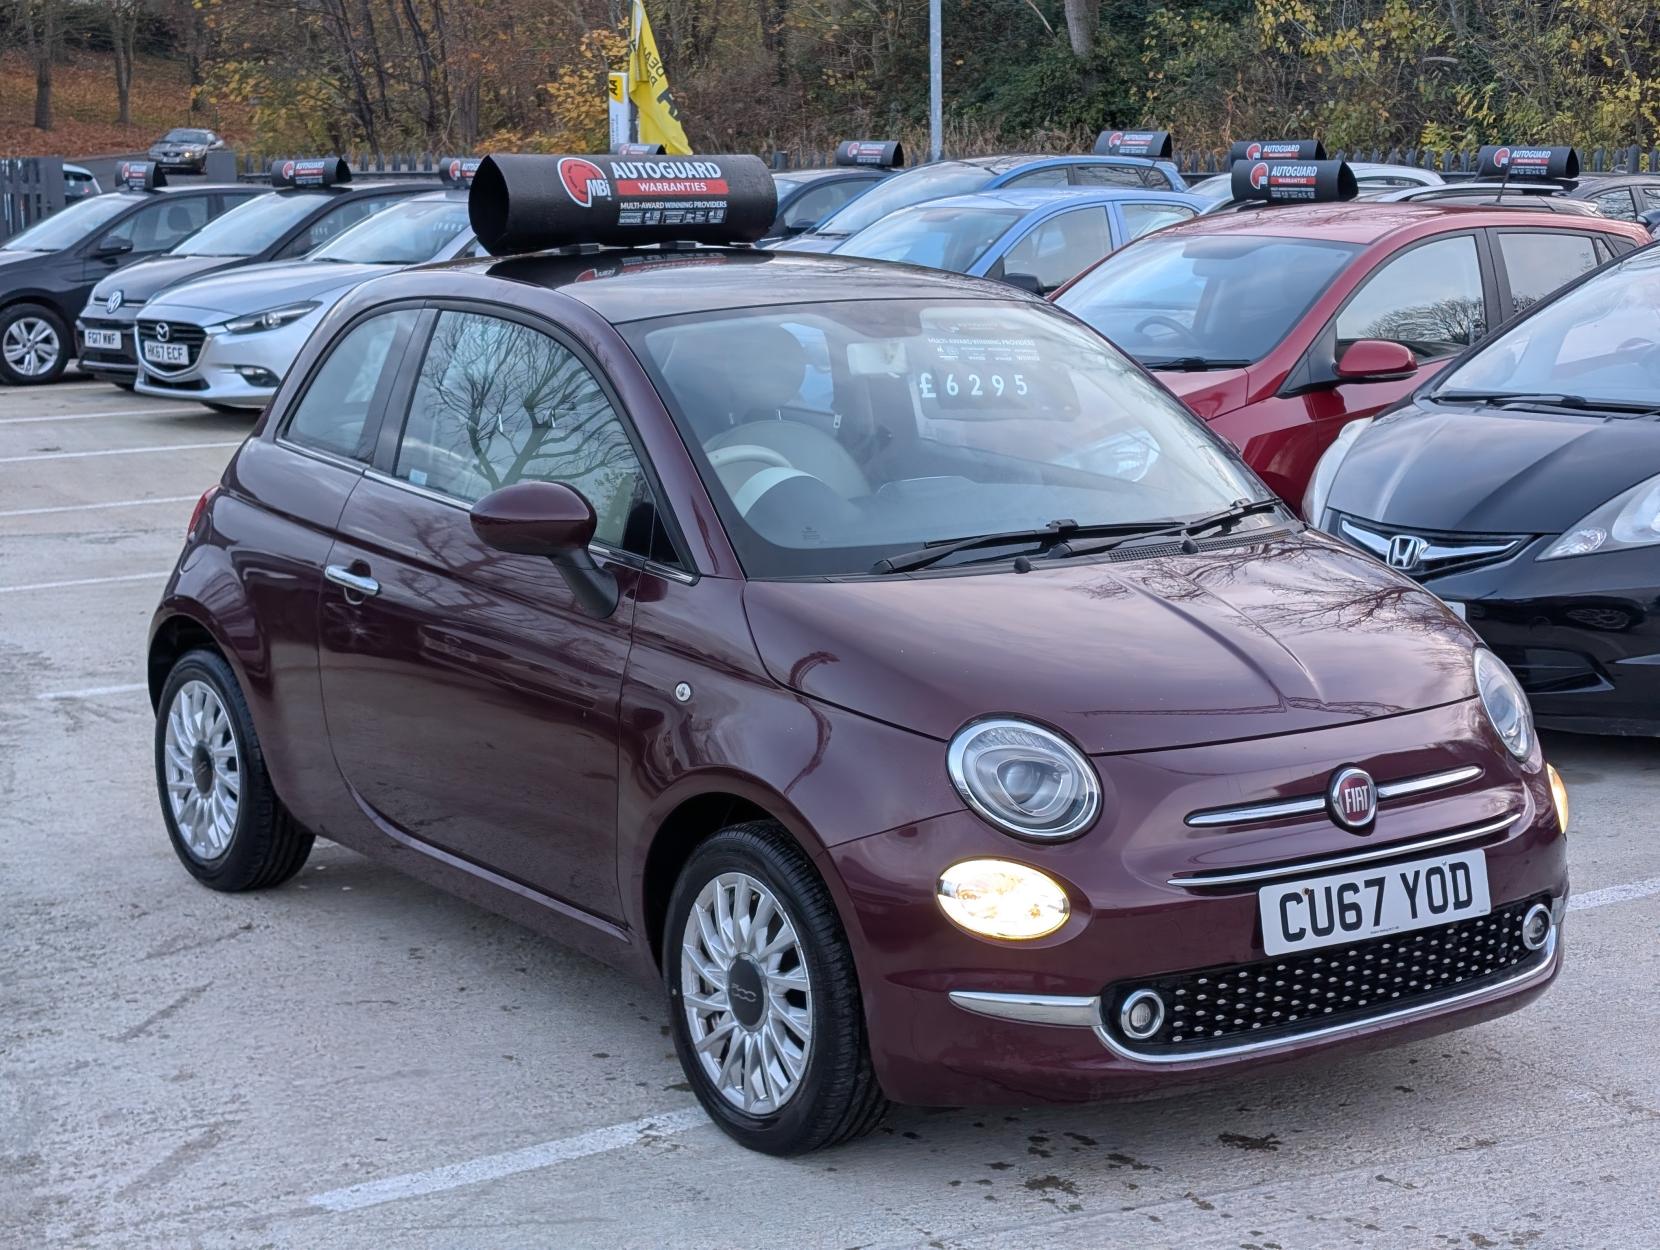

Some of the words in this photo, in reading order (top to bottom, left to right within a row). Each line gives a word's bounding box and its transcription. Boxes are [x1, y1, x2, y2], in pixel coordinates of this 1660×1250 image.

[1263, 144, 1300, 153] AUTOGUARD
[1511, 150, 1552, 159] AUTOGUARD
[610, 161, 722, 179] AUTOGUARD
[1271, 166, 1317, 176] AUTOGUARD
[638, 182, 708, 193] WARRANTIES
[620, 202, 665, 210] MULTI-AWARD
[665, 201, 694, 209] WINNING
[694, 200, 728, 209] PROVIDERS
[147, 344, 165, 359] HK67
[167, 345, 183, 361] ECF
[1344, 785, 1370, 814] FIAT
[1279, 876, 1386, 943] CU67
[1399, 861, 1473, 920] YOD
